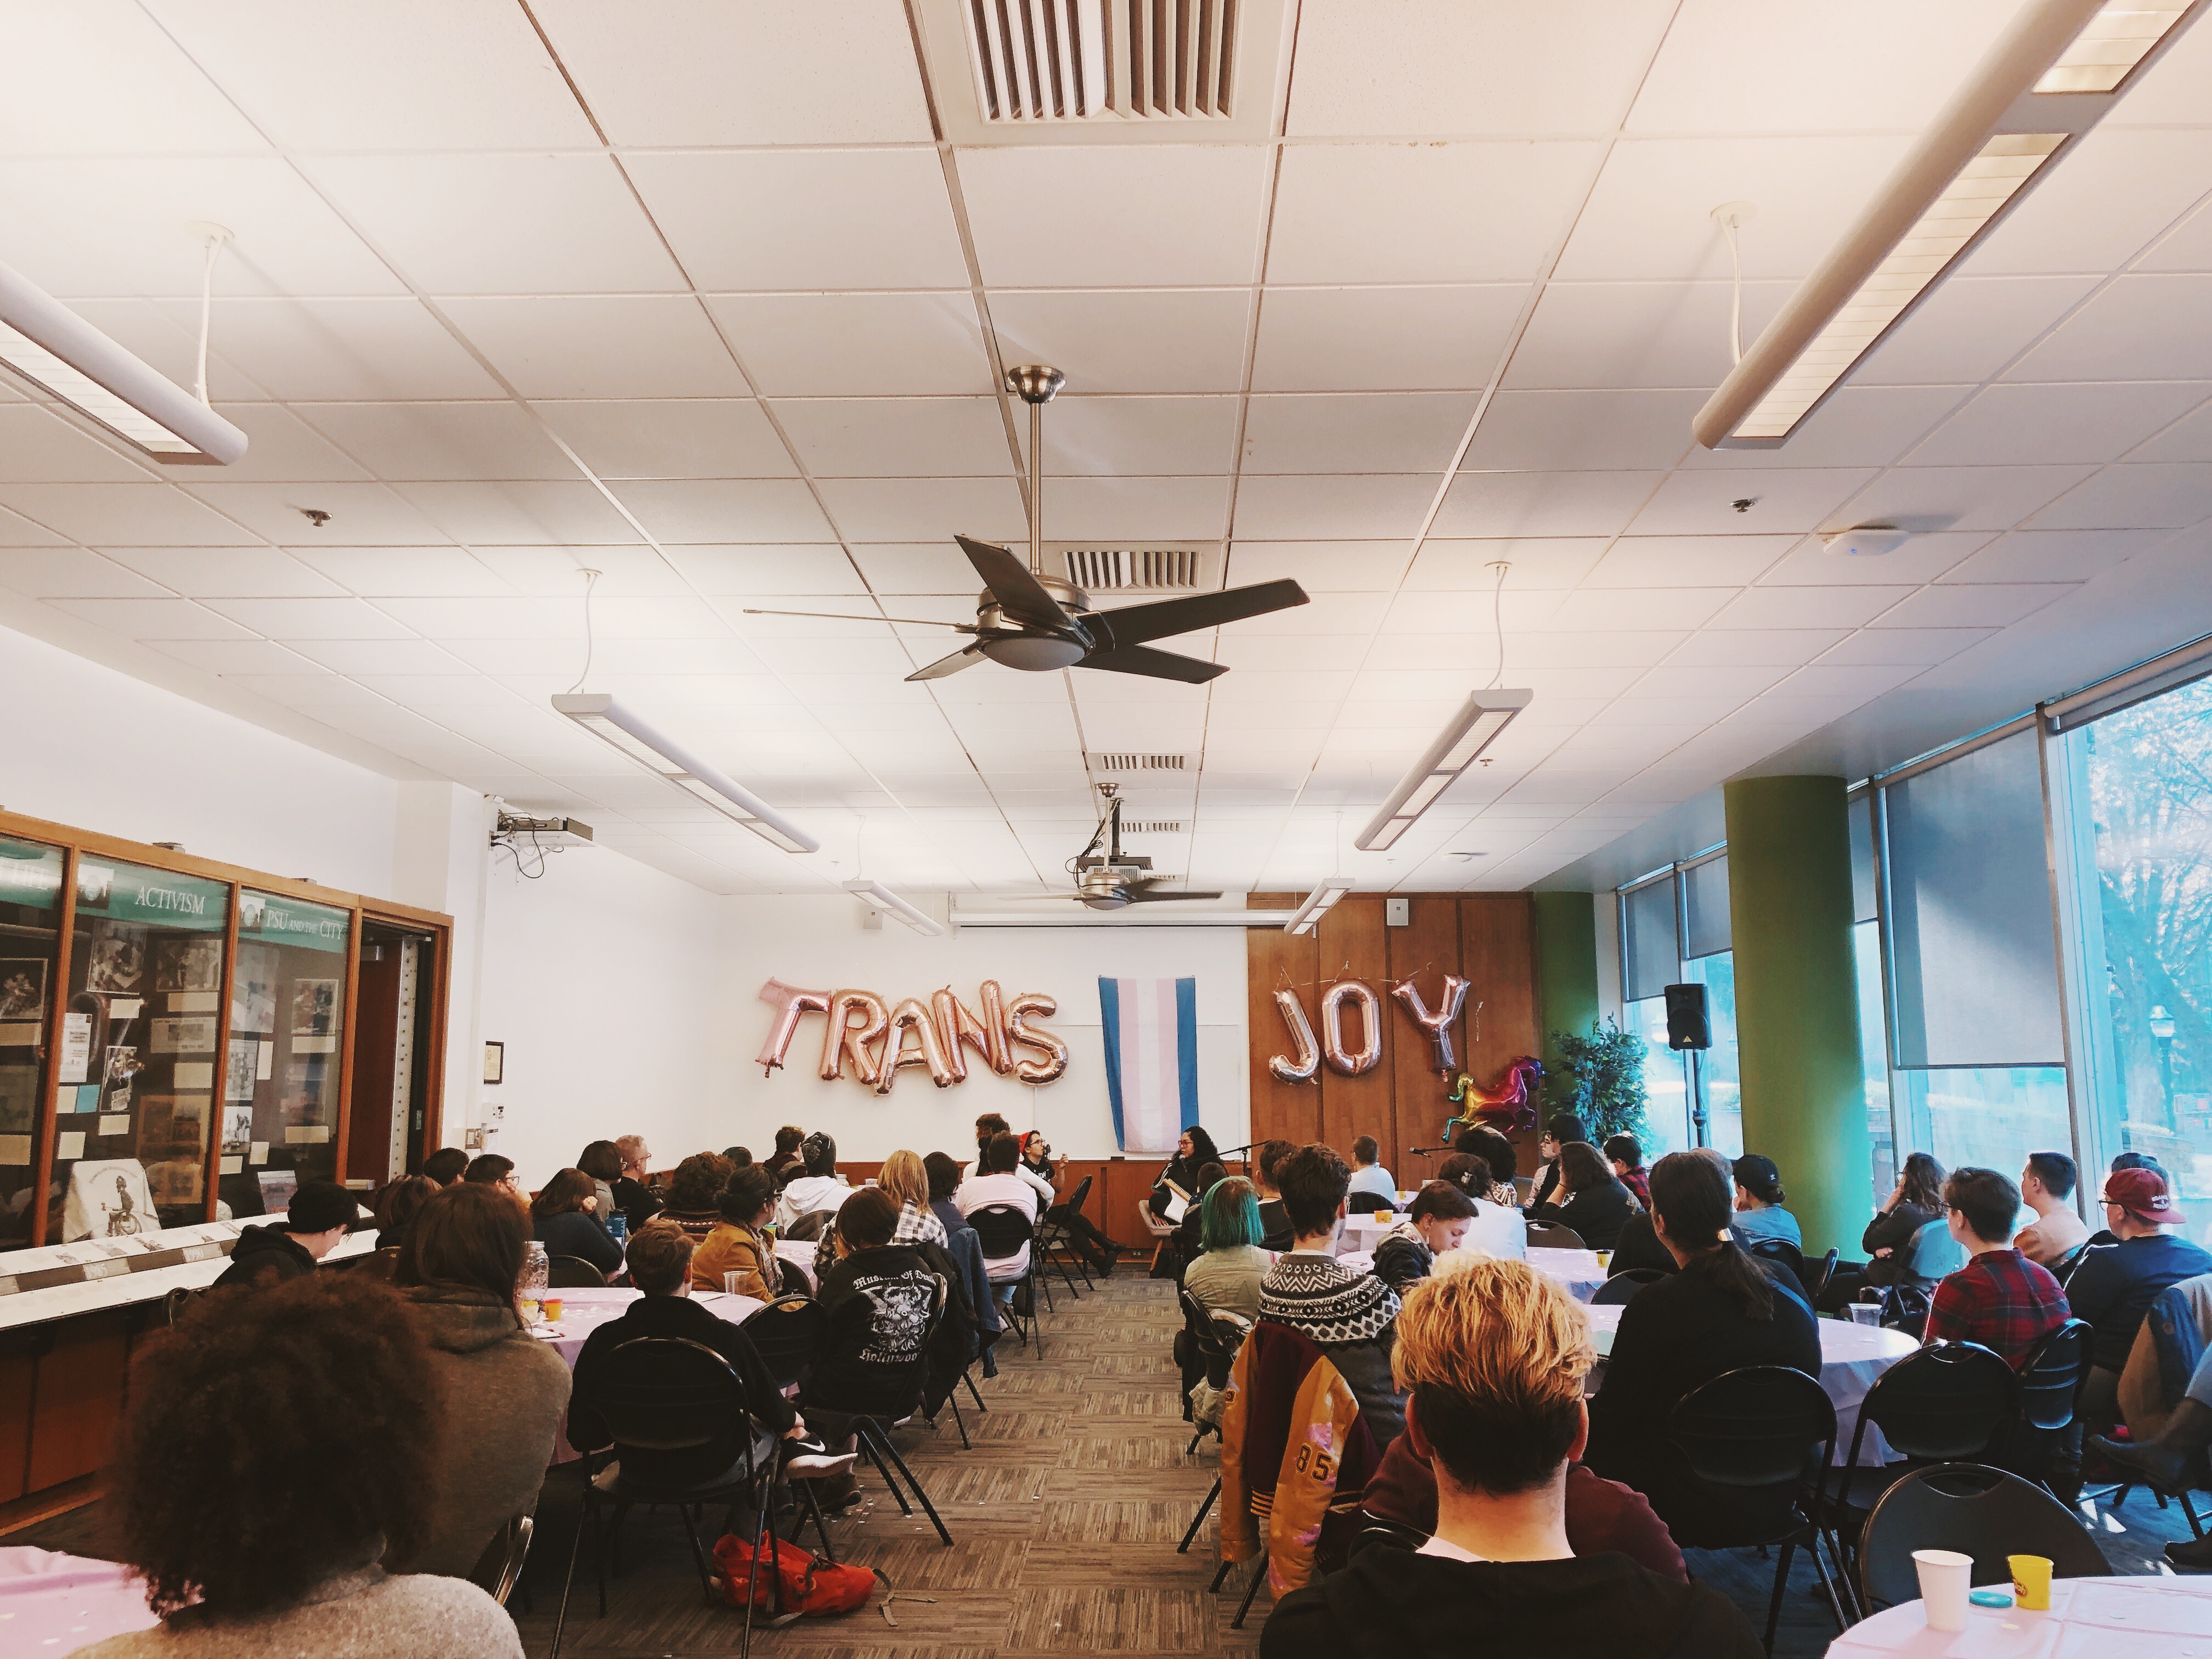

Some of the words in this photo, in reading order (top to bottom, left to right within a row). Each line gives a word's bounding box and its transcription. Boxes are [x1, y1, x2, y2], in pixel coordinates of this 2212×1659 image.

[135, 885, 205, 914] ACTIVISM
[266, 909, 289, 930] PSU
[289, 919, 304, 932] AND
[320, 920, 344, 940] CITY
[755, 977, 1069, 1097] TRANS
[1269, 974, 1471, 1085] JOY
[901, 1270, 913, 1281] Of
[857, 1348, 922, 1364] Hollywoo
[1296, 1442, 1332, 1482] 85
